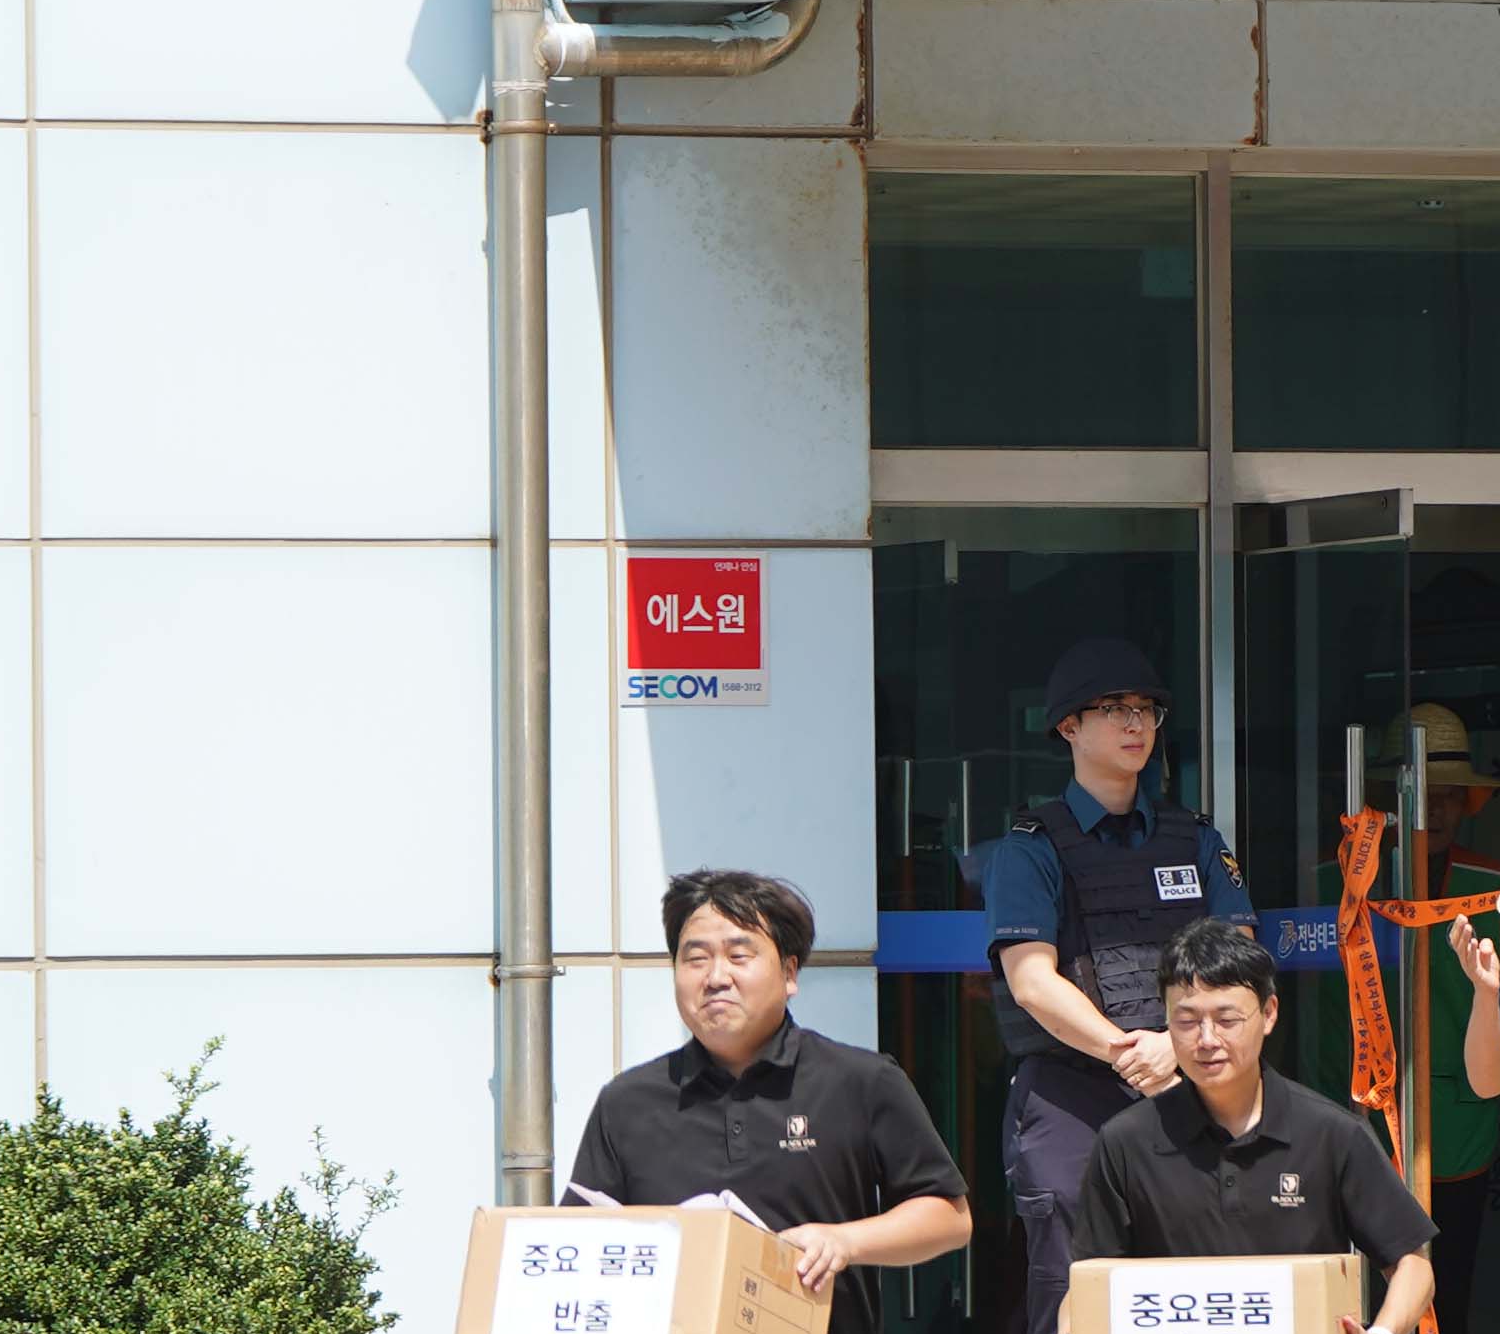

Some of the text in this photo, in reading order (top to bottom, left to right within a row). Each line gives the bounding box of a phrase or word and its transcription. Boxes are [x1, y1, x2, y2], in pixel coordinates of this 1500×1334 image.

[646, 593, 746, 634] 에스원
[628, 674, 762, 699] SECOM 1588-3112
[1352, 838, 1372, 875] POLICE
[1164, 887, 1197, 897] POLICE
[521, 1243, 659, 1277] 중요 물품
[553, 1299, 612, 1333] 반출
